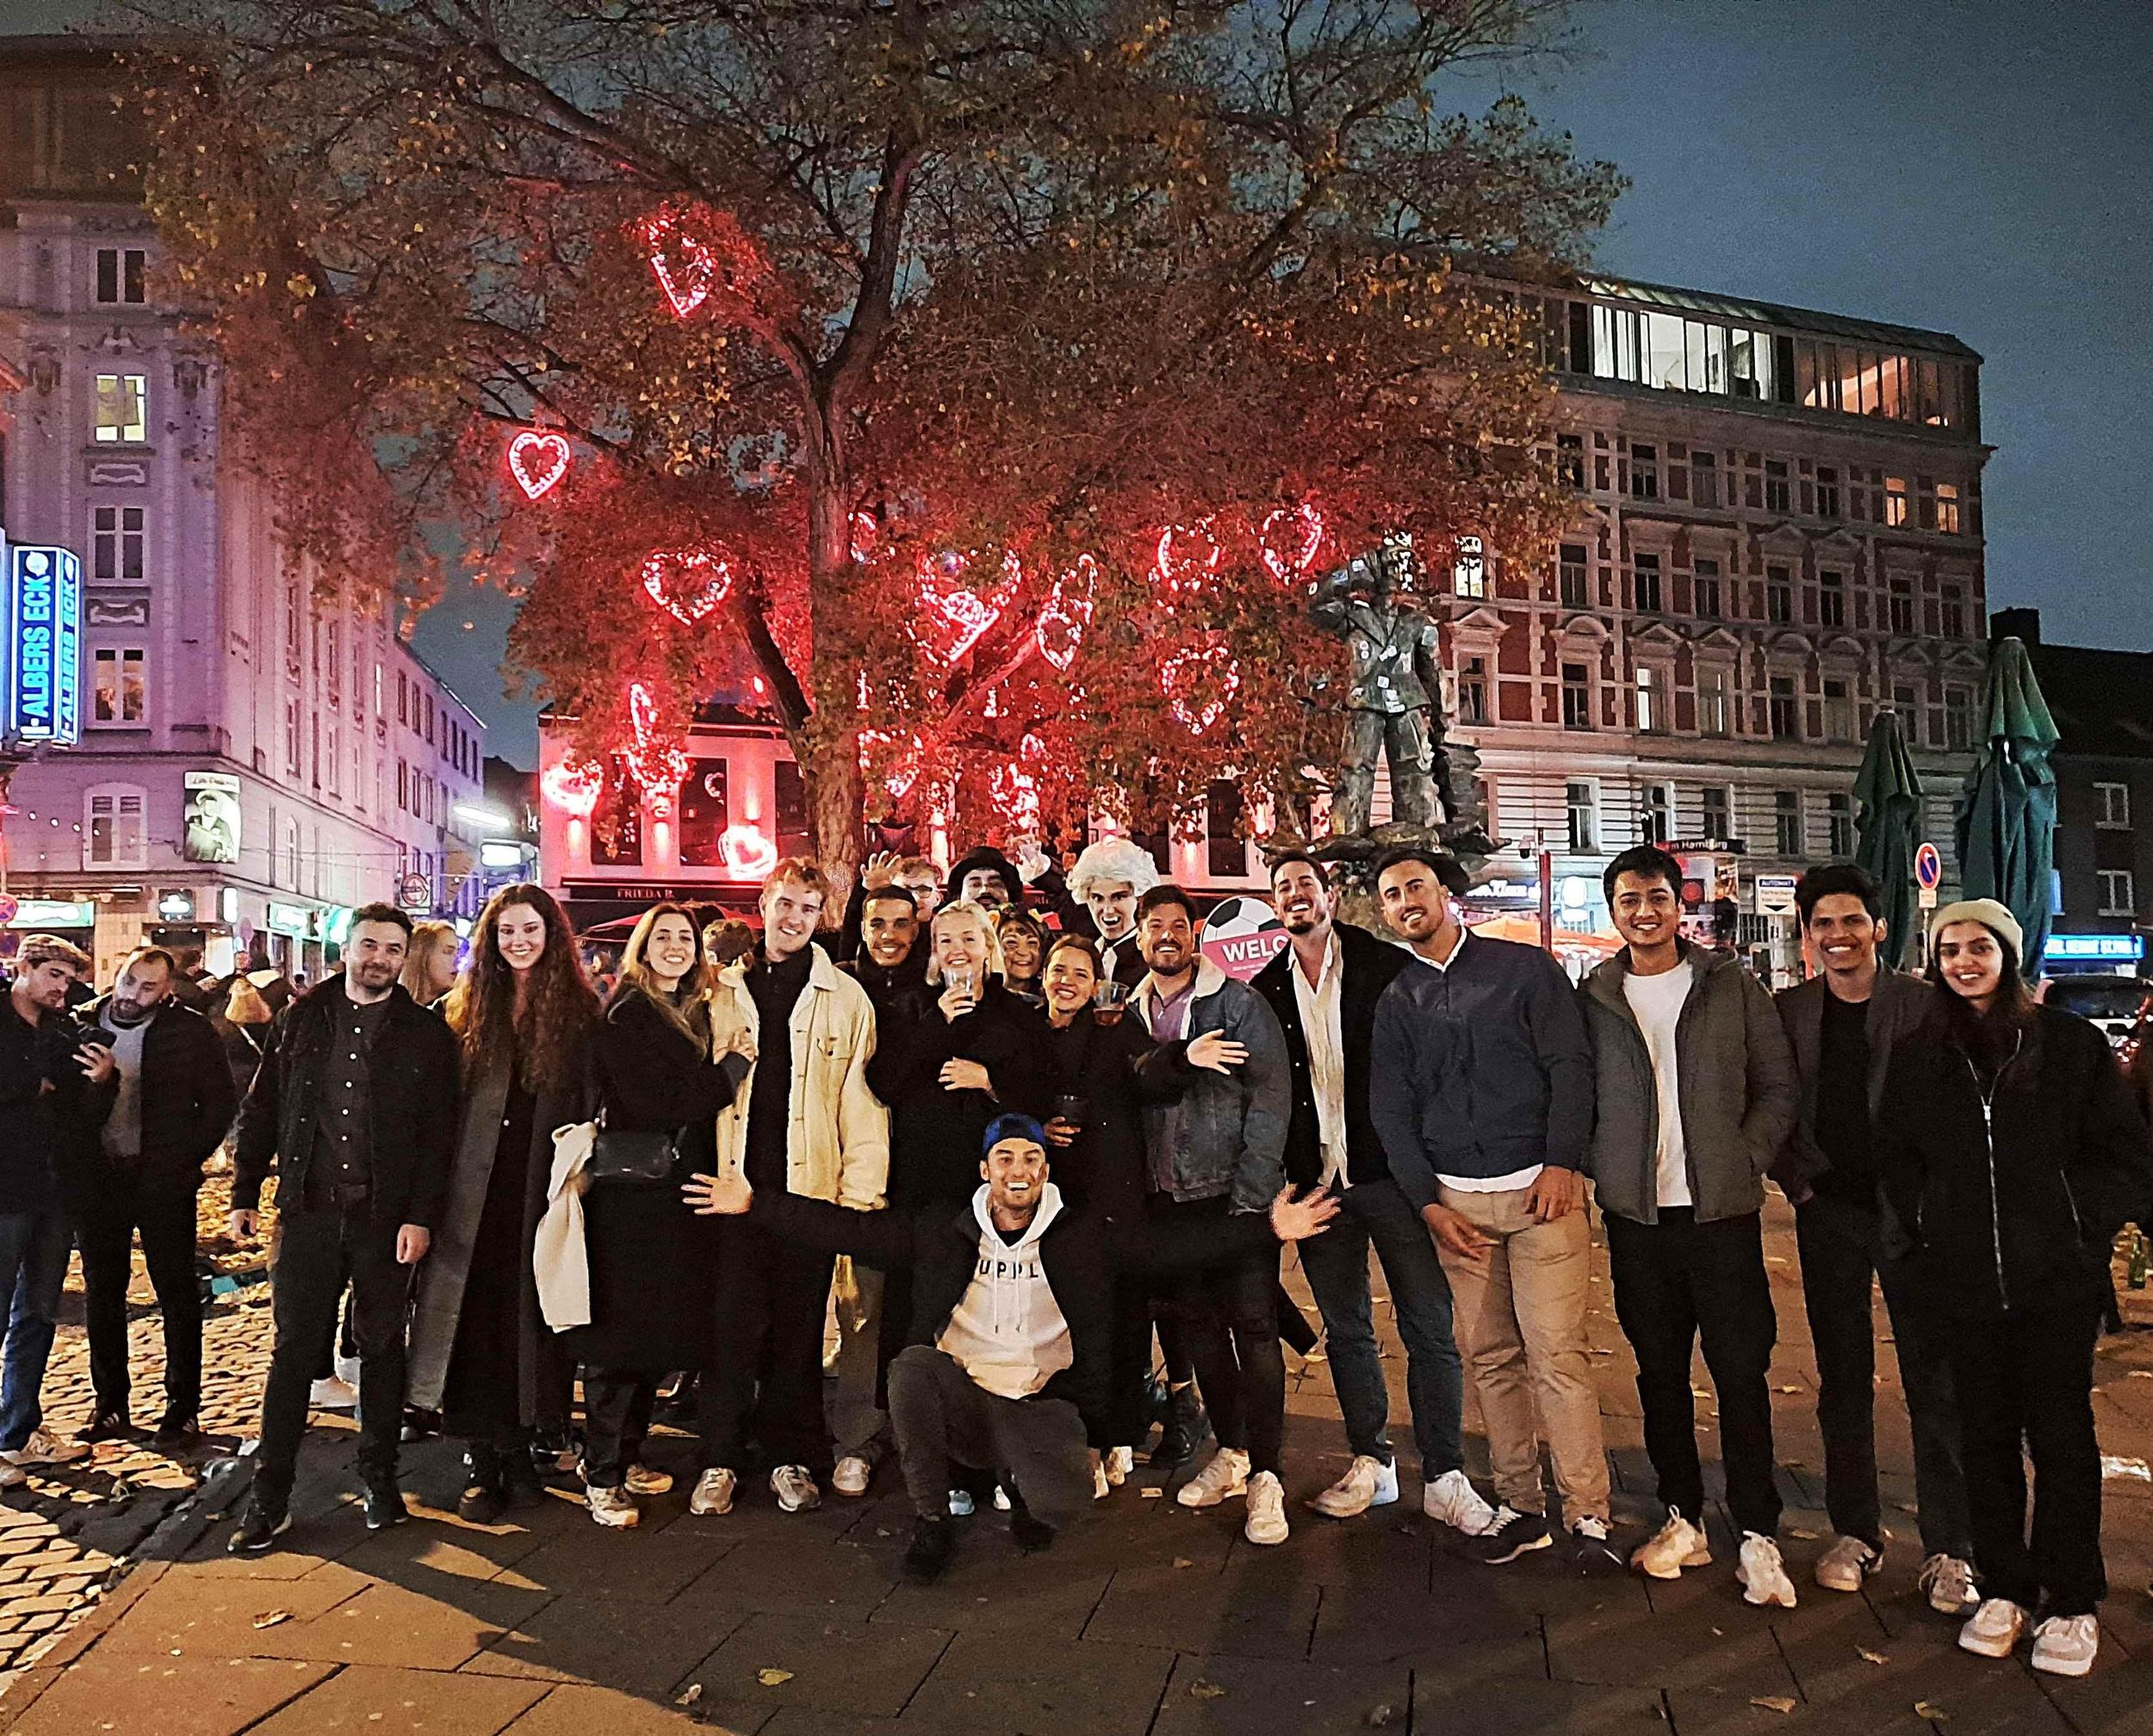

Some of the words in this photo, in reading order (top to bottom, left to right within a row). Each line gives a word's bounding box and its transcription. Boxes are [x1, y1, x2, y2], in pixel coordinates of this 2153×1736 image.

[22, 574, 51, 621] ECK
[22, 626, 50, 718] ALBERS
[617, 889, 661, 898] FRIEDA
